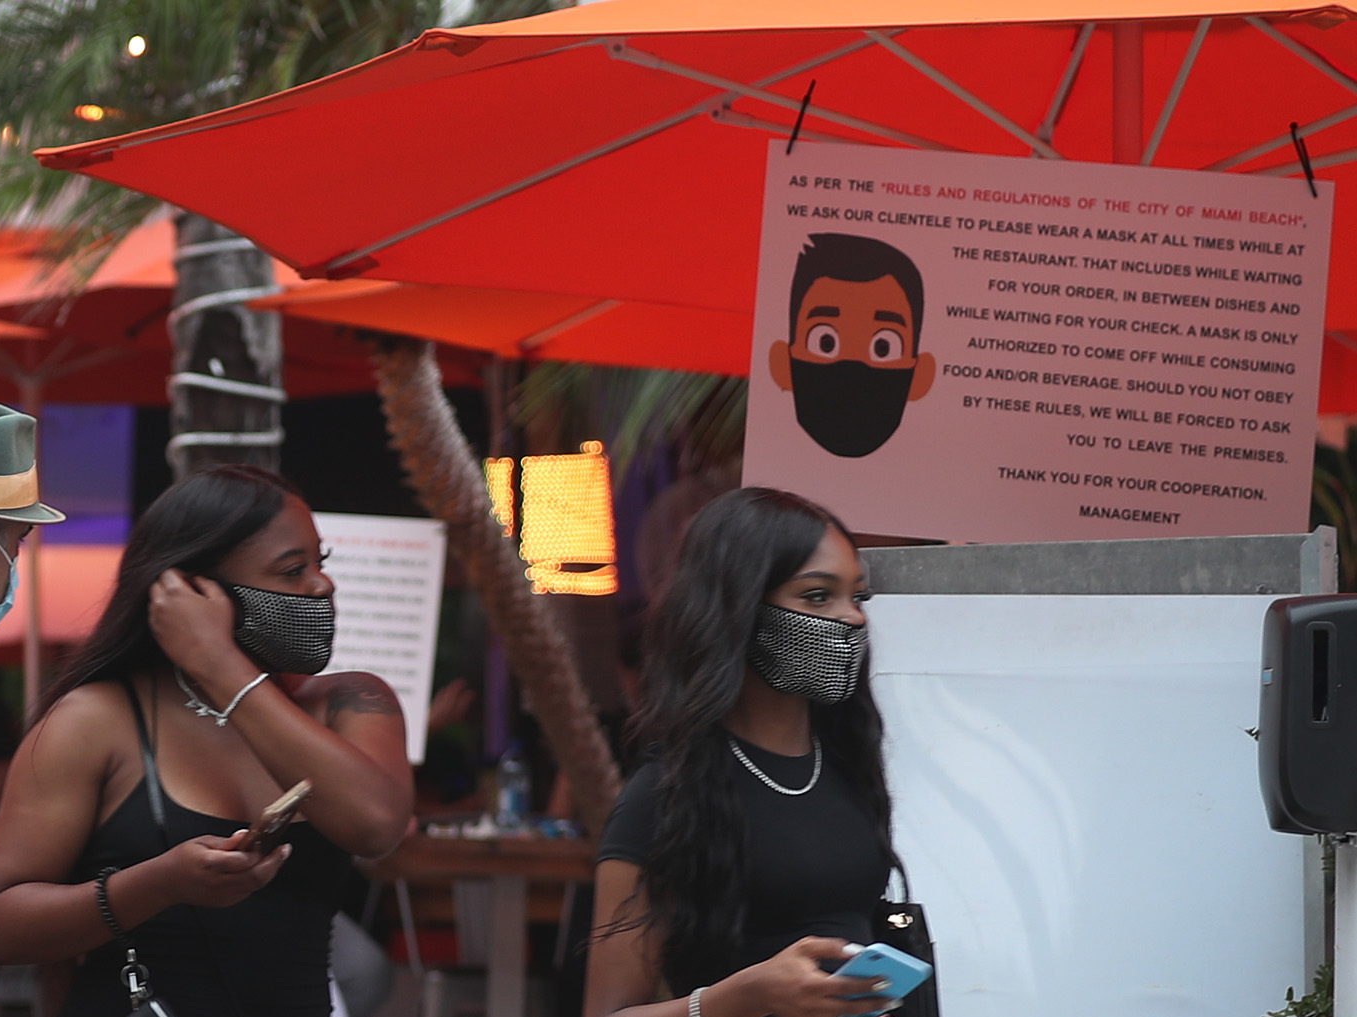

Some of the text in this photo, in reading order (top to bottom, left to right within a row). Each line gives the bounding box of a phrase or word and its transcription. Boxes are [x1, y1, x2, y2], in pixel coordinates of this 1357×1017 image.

[788, 175, 808, 188] AS
[813, 176, 842, 191] PER
[847, 179, 875, 194] THE
[936, 186, 967, 201] AND
[972, 189, 1072, 209] REGULATIONS
[1077, 197, 1097, 210] OF
[1104, 199, 1131, 214] THE
[1137, 201, 1170, 216] CITY
[1175, 205, 1195, 218] OF
[1201, 206, 1243, 222] MIAMI
[786, 204, 1305, 257] WE ASK OUR CLIENTELE TO PLEASE WEAR A MASK AT ALL TIMES WHILE AT
[952, 246, 1303, 287] THE RESTAURANT. THAT INCLUDES WHILE WAITING
[987, 279, 1301, 316] FOR YOUR ORDER, IN BETWEEN DISHES AND
[946, 305, 1299, 346] WHILE WAITING FOR YOUR CHECK. A MASK IS ONLY
[967, 336, 1296, 375] AUTHORIZED TO COME OFF WHILE CONSUMING
[942, 364, 1294, 405] FOOD AND/OR BEVERAGE. SHOULD YOU NOT OBEY
[962, 395, 1291, 434] BY THESE RULES, WE WILL BE FORCED TO ASK
[1066, 433, 1288, 464] YOU TO LEAVE THE PREMISES.
[998, 466, 1267, 501] THANK YOU FOR YOUR COOPERATION.
[1078, 505, 1181, 525] MANAGEMENT
